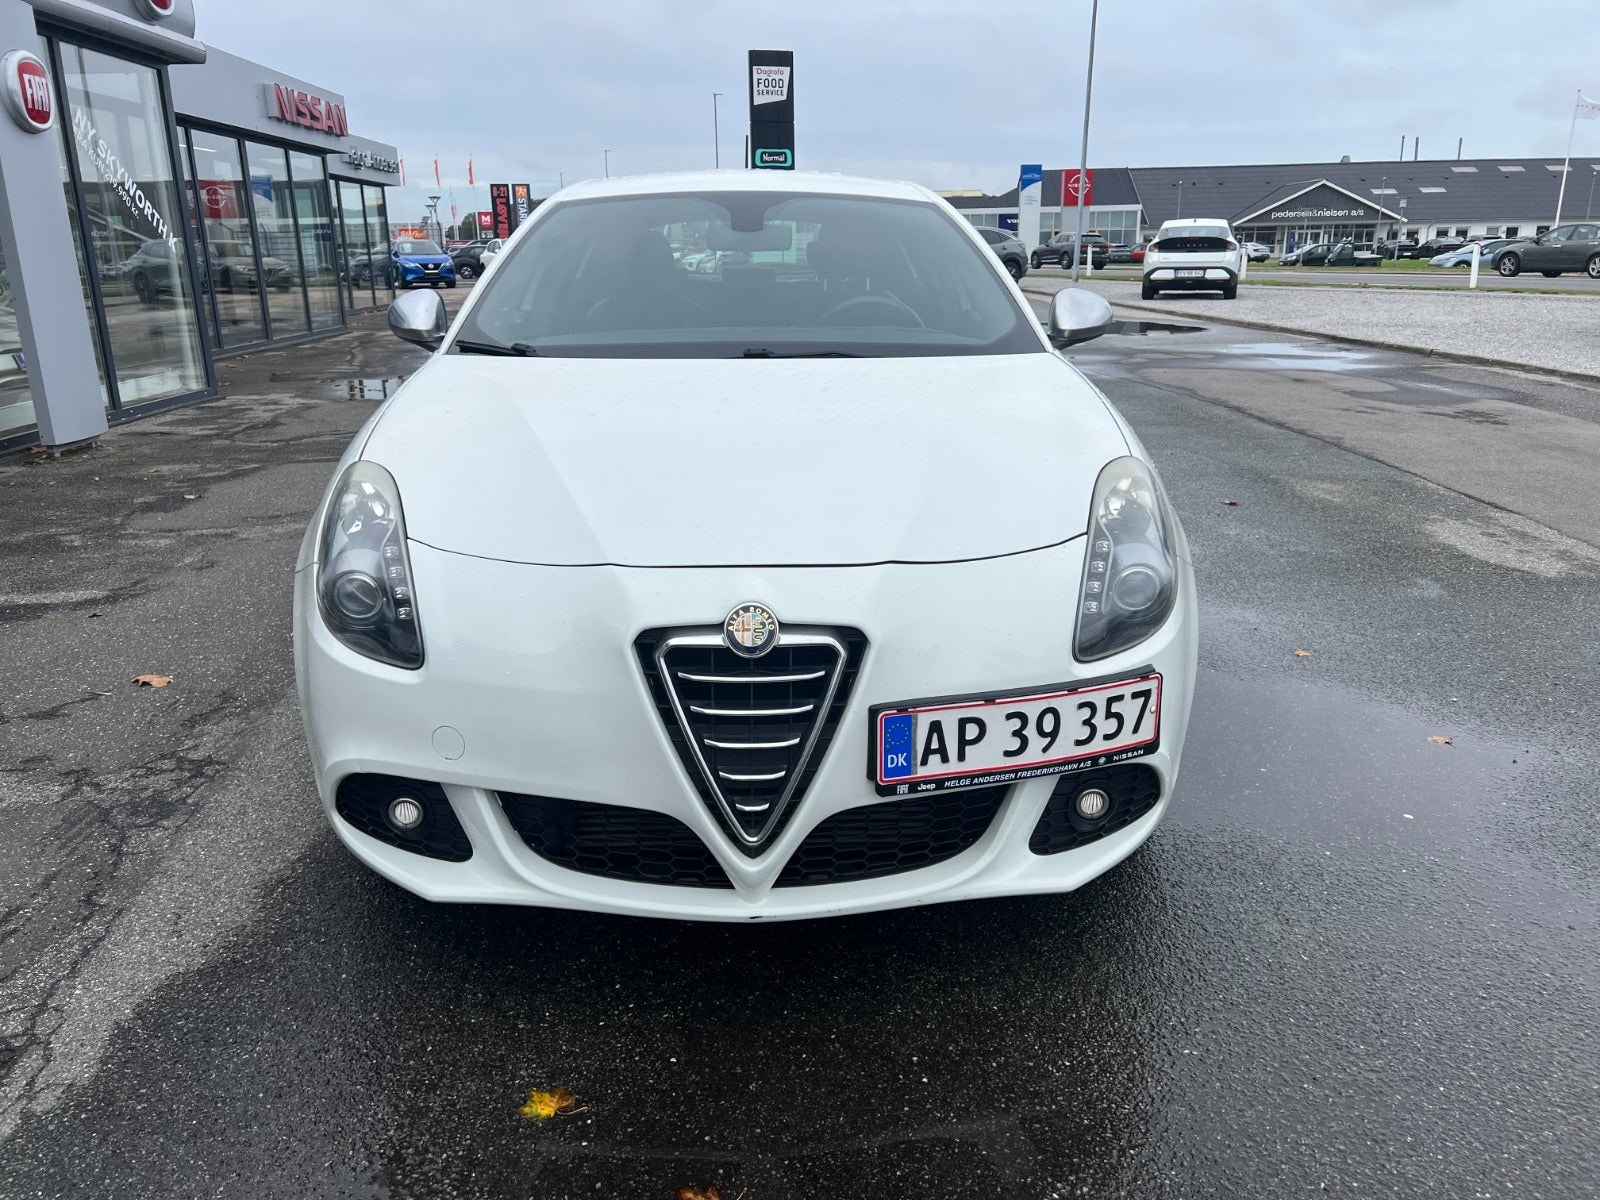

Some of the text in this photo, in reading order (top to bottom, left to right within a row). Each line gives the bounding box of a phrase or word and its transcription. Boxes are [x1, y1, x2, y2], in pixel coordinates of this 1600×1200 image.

[22, 73, 49, 112] FIAT
[757, 79, 784, 88] FOOD
[272, 83, 348, 137] NISSAN
[76, 108, 96, 140] NY
[97, 139, 168, 240] SKYWORTH
[762, 153, 785, 161] Normal
[728, 607, 774, 632] ALFA ROMEO
[920, 688, 1152, 767] AP 39 357
[887, 753, 907, 768] DK
[896, 749, 1144, 795] FIAT Jeep HELGE ANDERSEN FREDERIKSHAVN A/S NISSAN
